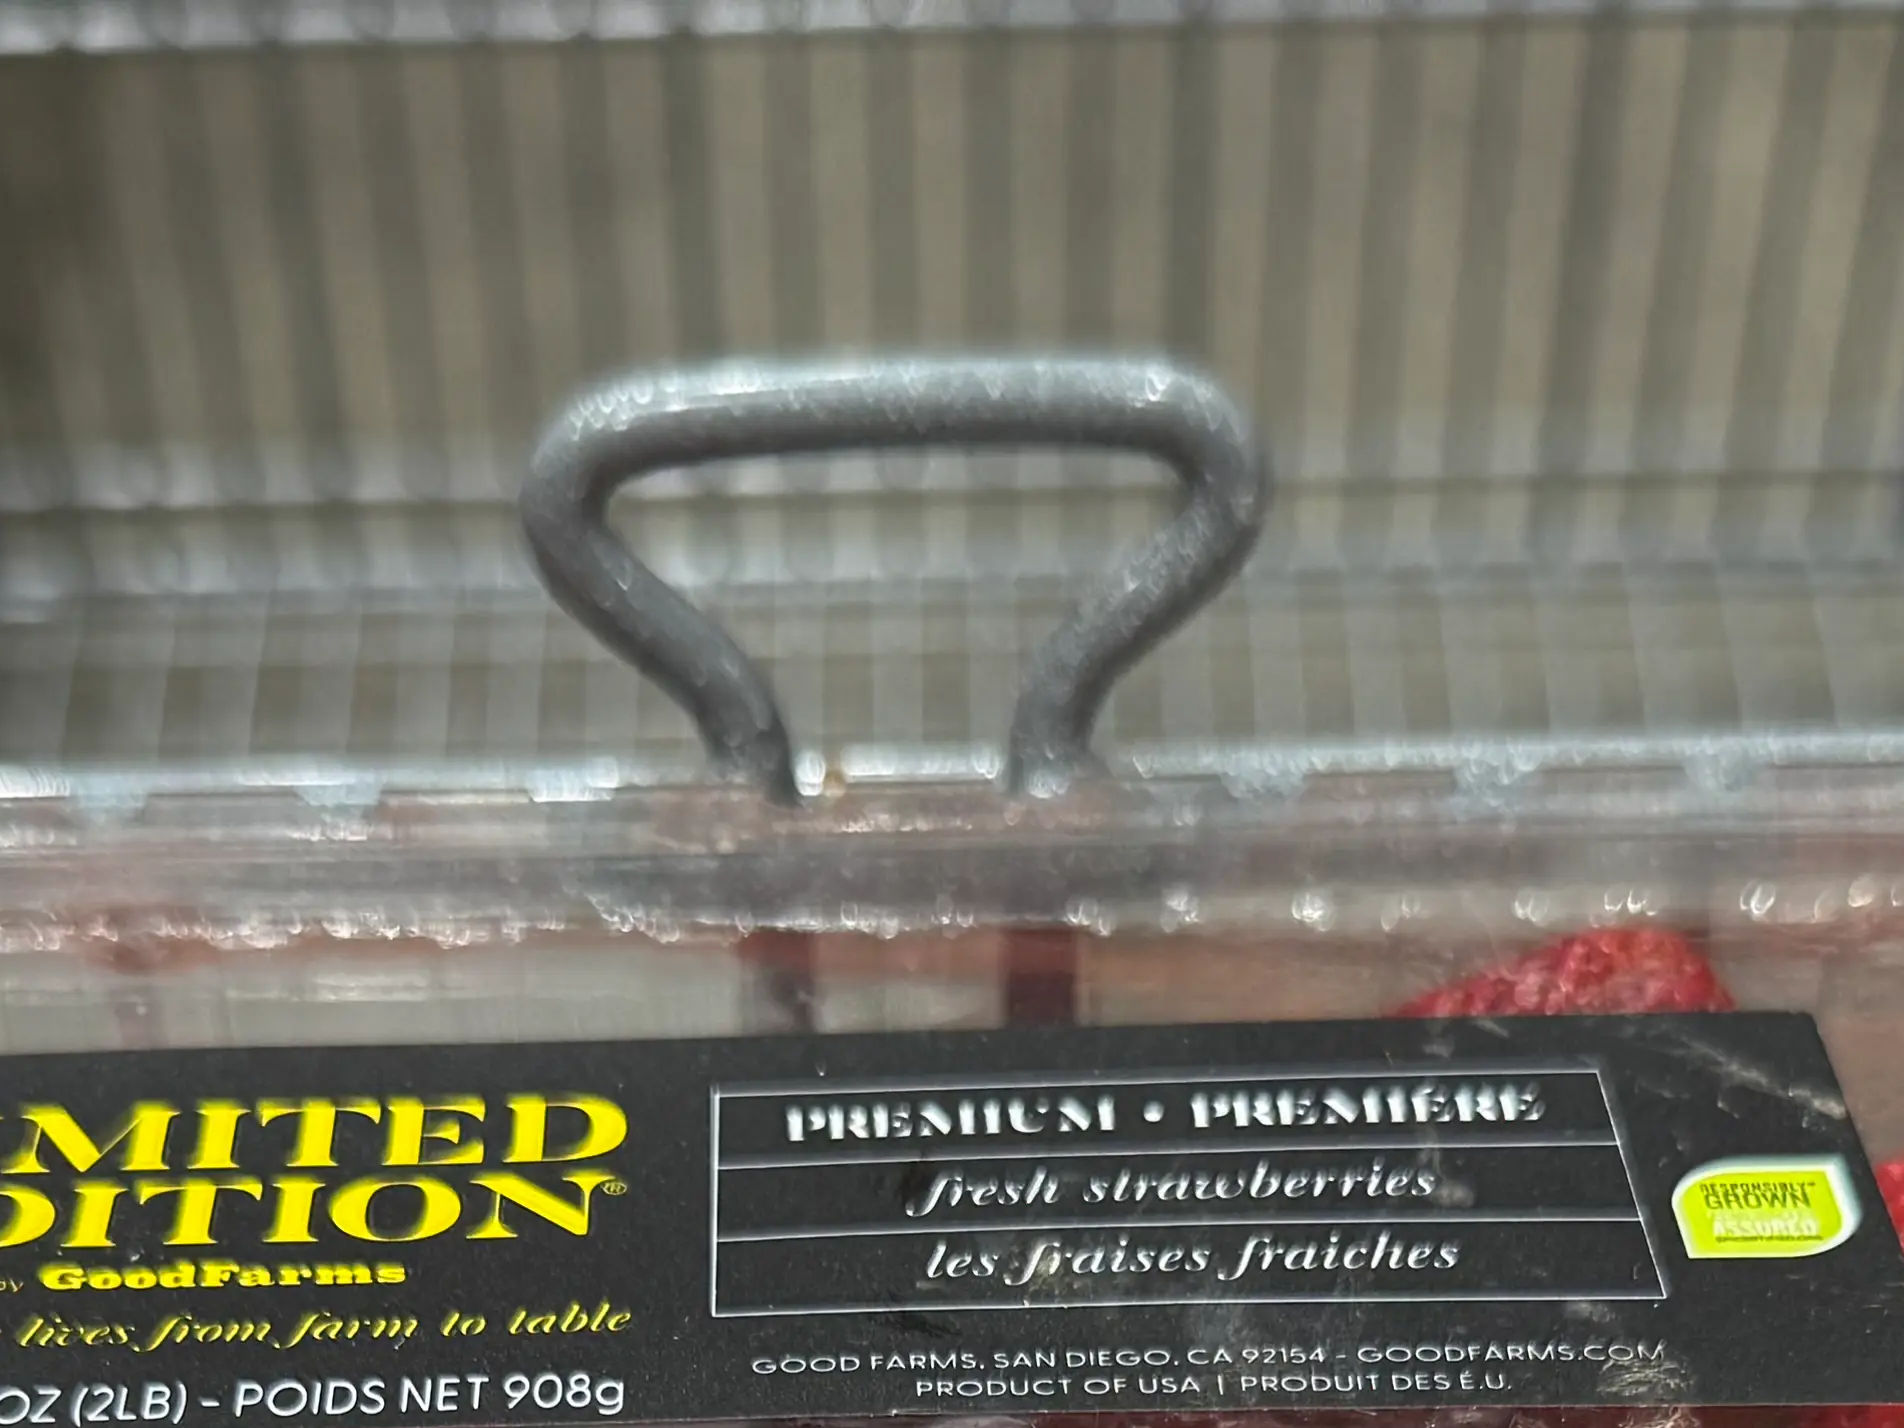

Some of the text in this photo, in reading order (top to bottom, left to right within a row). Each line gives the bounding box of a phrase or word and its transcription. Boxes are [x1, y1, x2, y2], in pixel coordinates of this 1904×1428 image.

[785, 1093, 1117, 1142] PREMIUM
[904, 1156, 1438, 1218] fresh strawberries
[1705, 1191, 1812, 1211] GROWN
[37, 1258, 407, 1291] GoodFarms
[926, 1238, 1000, 1279] les
[1002, 1232, 1211, 1287] fraises
[16, 1311, 129, 1348] lives
[132, 1310, 273, 1353] from
[273, 1306, 419, 1351] farm
[440, 1309, 487, 1339] to
[506, 1298, 634, 1336] table
[751, 1355, 861, 1375] GOOD
[994, 1350, 1057, 1370] SAN
[1186, 1347, 1234, 1366] CA
[1241, 1346, 1326, 1365] 92154
[1357, 1342, 1666, 1364] GOODFARMS.COM
[69, 1381, 188, 1427] (2LB)
[232, 1378, 387, 1418] POIDS
[400, 1374, 491, 1414] NET
[502, 1371, 626, 1416] 908g
[915, 1377, 1074, 1398] PRODUCT
[1083, 1377, 1128, 1396] OF
[1137, 1375, 1202, 1395] USA
[1241, 1374, 1381, 1393] PRODUIT
[1391, 1373, 1451, 1391] DES
